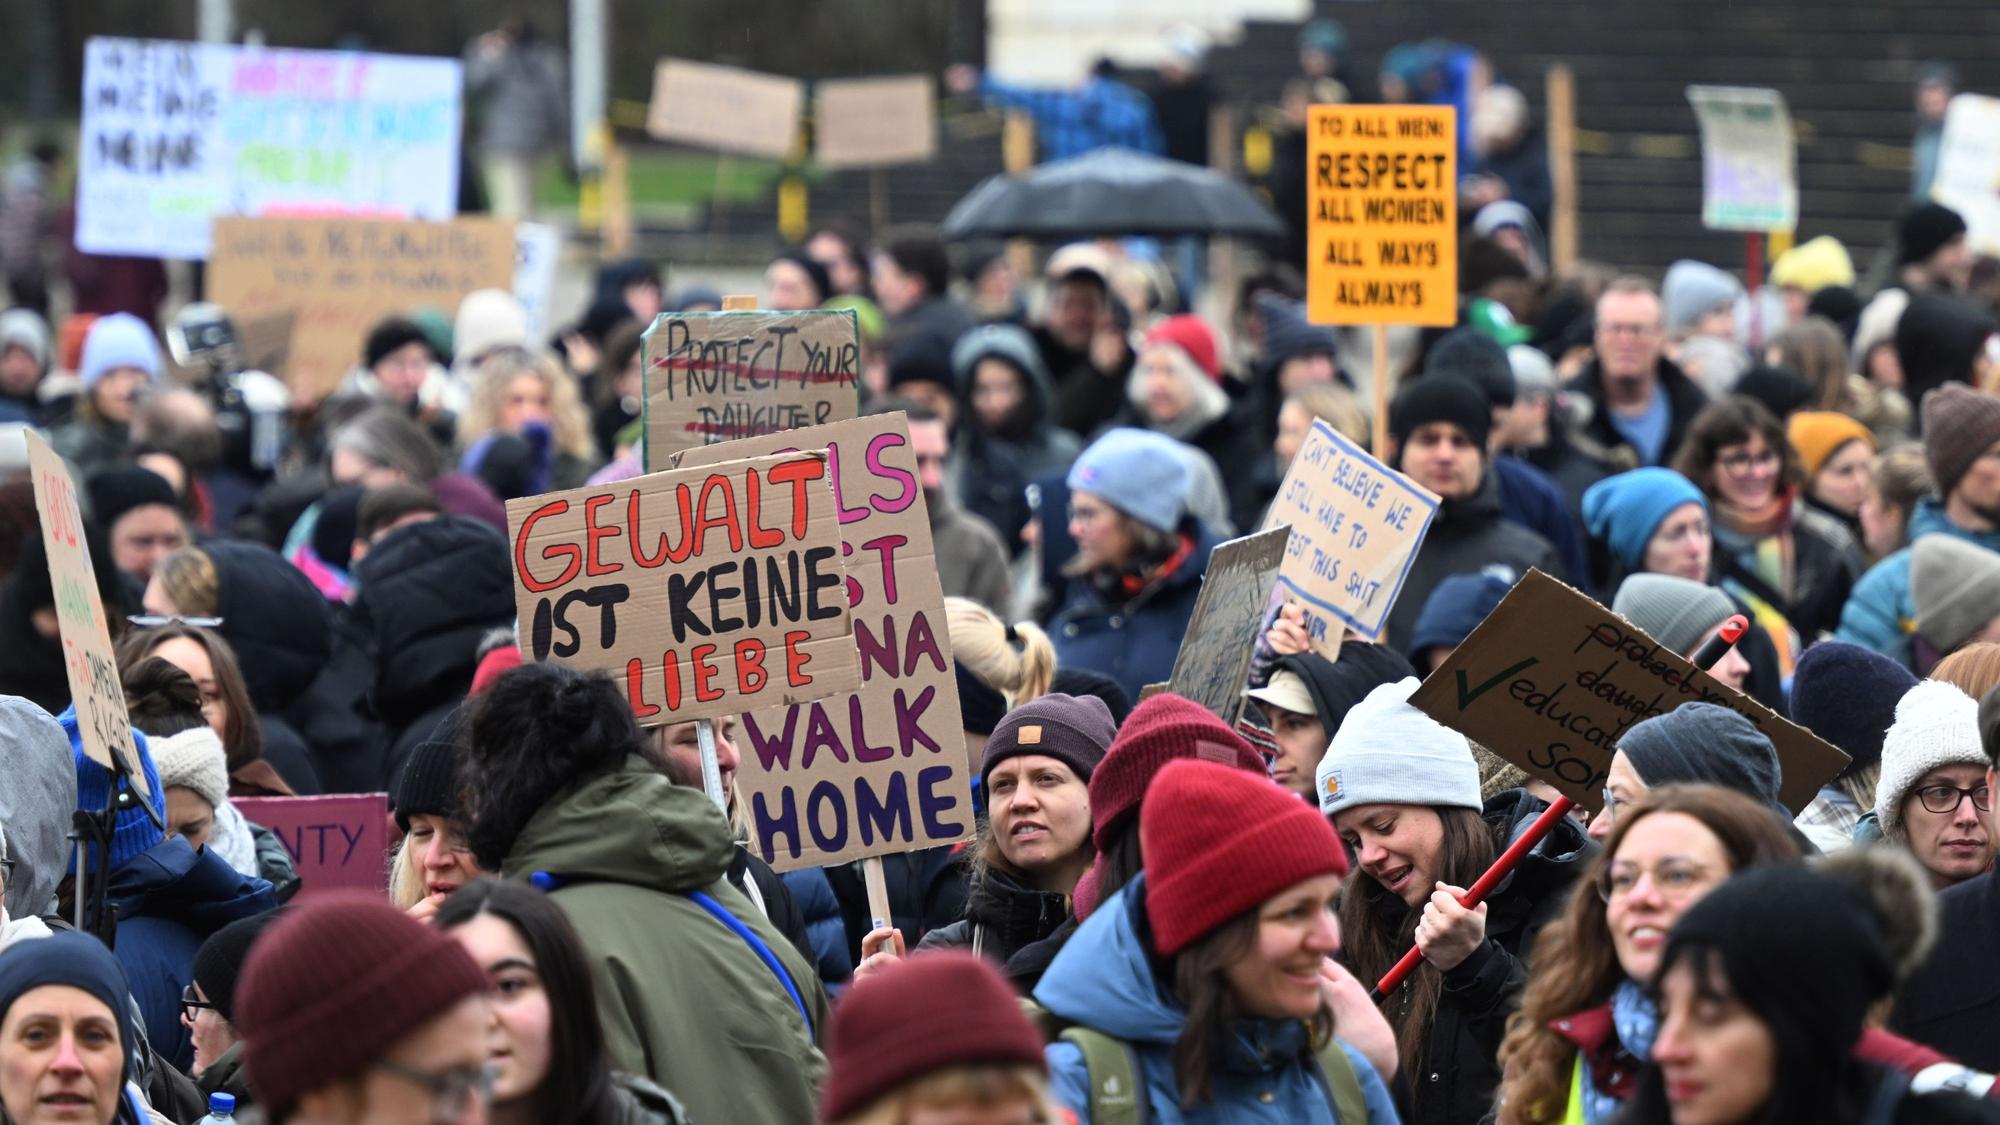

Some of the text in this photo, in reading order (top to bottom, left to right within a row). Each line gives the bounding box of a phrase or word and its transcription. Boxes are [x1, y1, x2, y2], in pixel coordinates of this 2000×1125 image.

[1319, 116, 1343, 137] TO
[1353, 117, 1388, 138] ALL
[1316, 153, 1446, 190] RESPECT
[1317, 198, 1445, 224] ALL WOMEN
[1325, 240, 1438, 267] ALL WAYS
[1336, 280, 1424, 307] ALWAYS
[668, 318, 858, 400] PROTECT YOUR
[697, 401, 832, 446] DAUGHTER
[515, 458, 824, 593] GEWALT
[1316, 499, 1345, 535] HAVE
[1349, 522, 1368, 550] TO
[1332, 458, 1384, 509] BELIEVE
[1384, 497, 1413, 532] WE
[532, 546, 842, 662] IST KEINE
[1310, 547, 1341, 582] THIS
[1345, 572, 1381, 608] SHIT
[626, 630, 813, 718] LIEBE
[1574, 623, 1700, 695] protect
[742, 685, 942, 772] WALK
[273, 823, 364, 866] NTY
[753, 765, 964, 865] HOME
